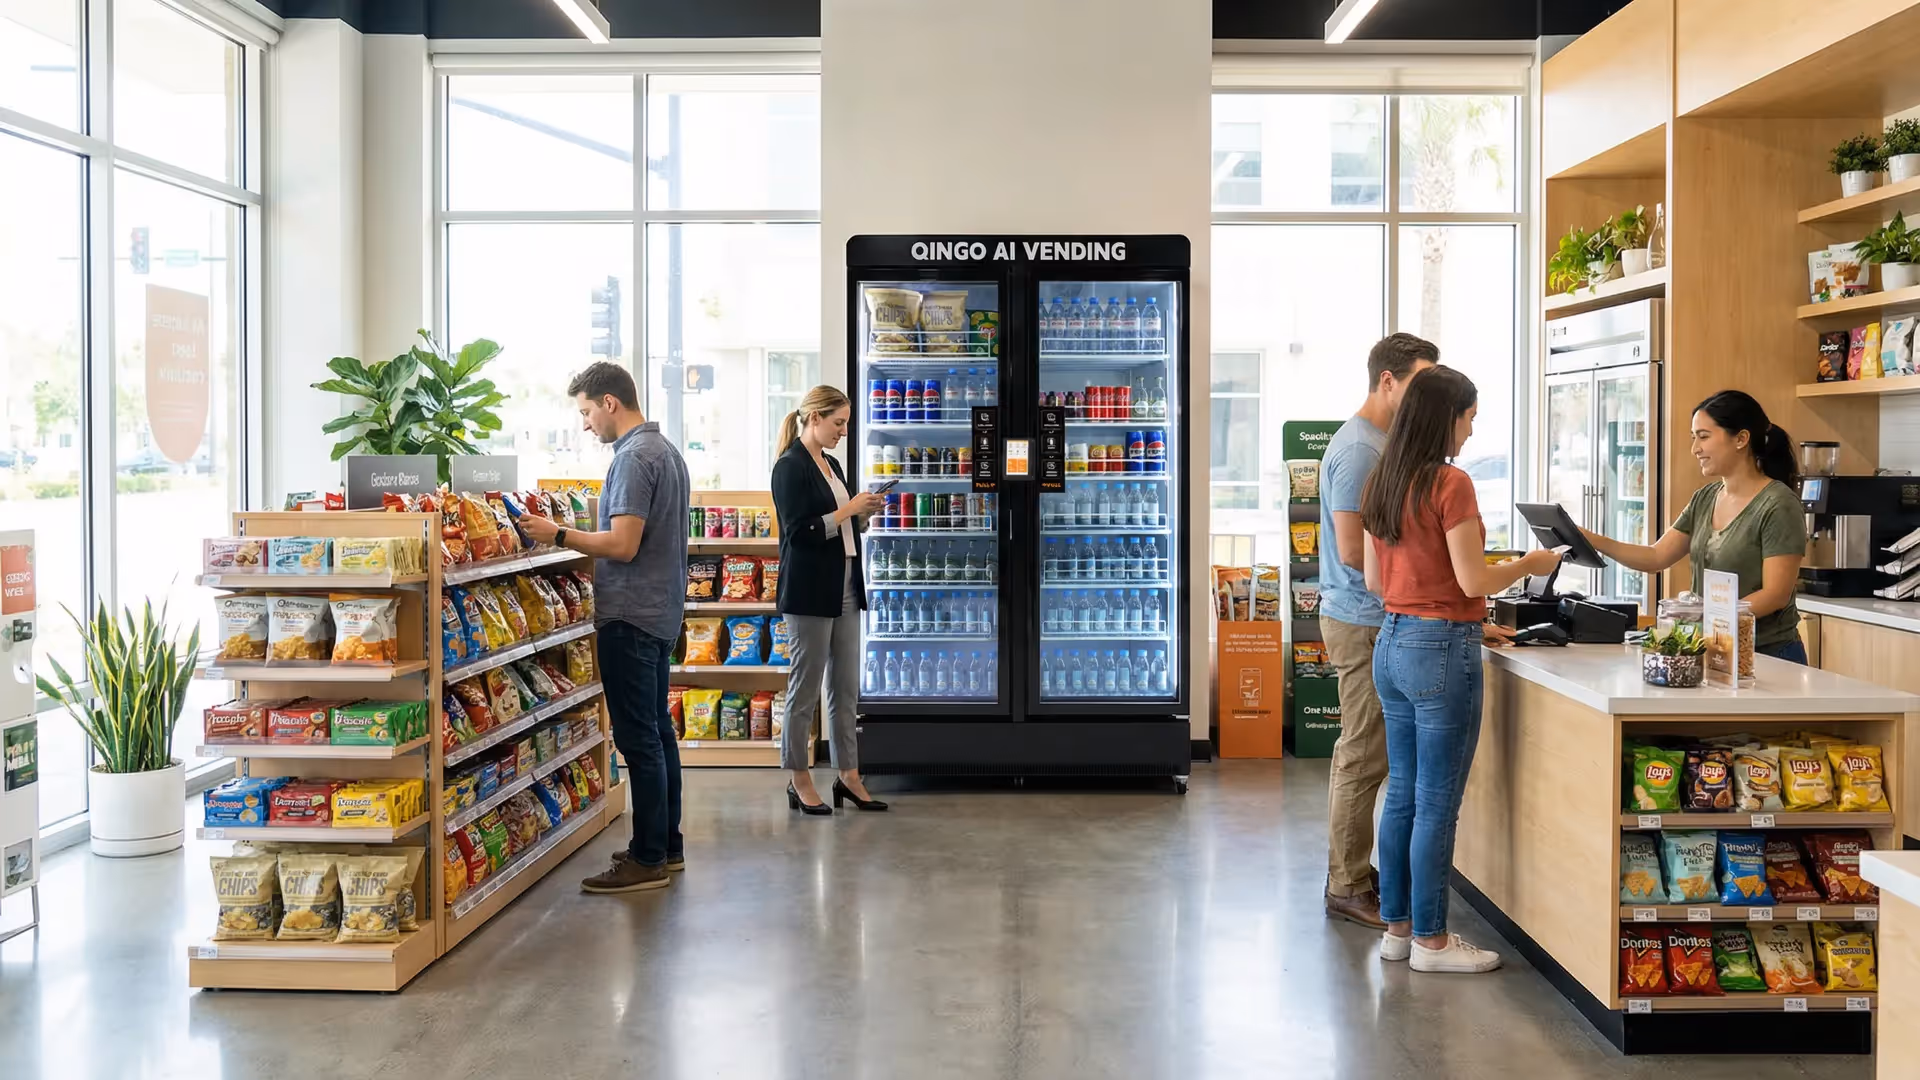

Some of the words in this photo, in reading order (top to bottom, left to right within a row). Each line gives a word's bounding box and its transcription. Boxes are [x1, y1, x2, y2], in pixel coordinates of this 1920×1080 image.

[911, 242, 986, 260] QINGO
[993, 242, 1015, 260] AI
[1023, 242, 1126, 260] VENDING
[876, 307, 906, 323] CHIPS
[924, 310, 953, 325] CHIPS
[219, 877, 257, 895] CHIPS
[347, 877, 387, 896] CHIPS
[1621, 938, 1662, 949] Doritos
[1668, 936, 1712, 948] Doritos
